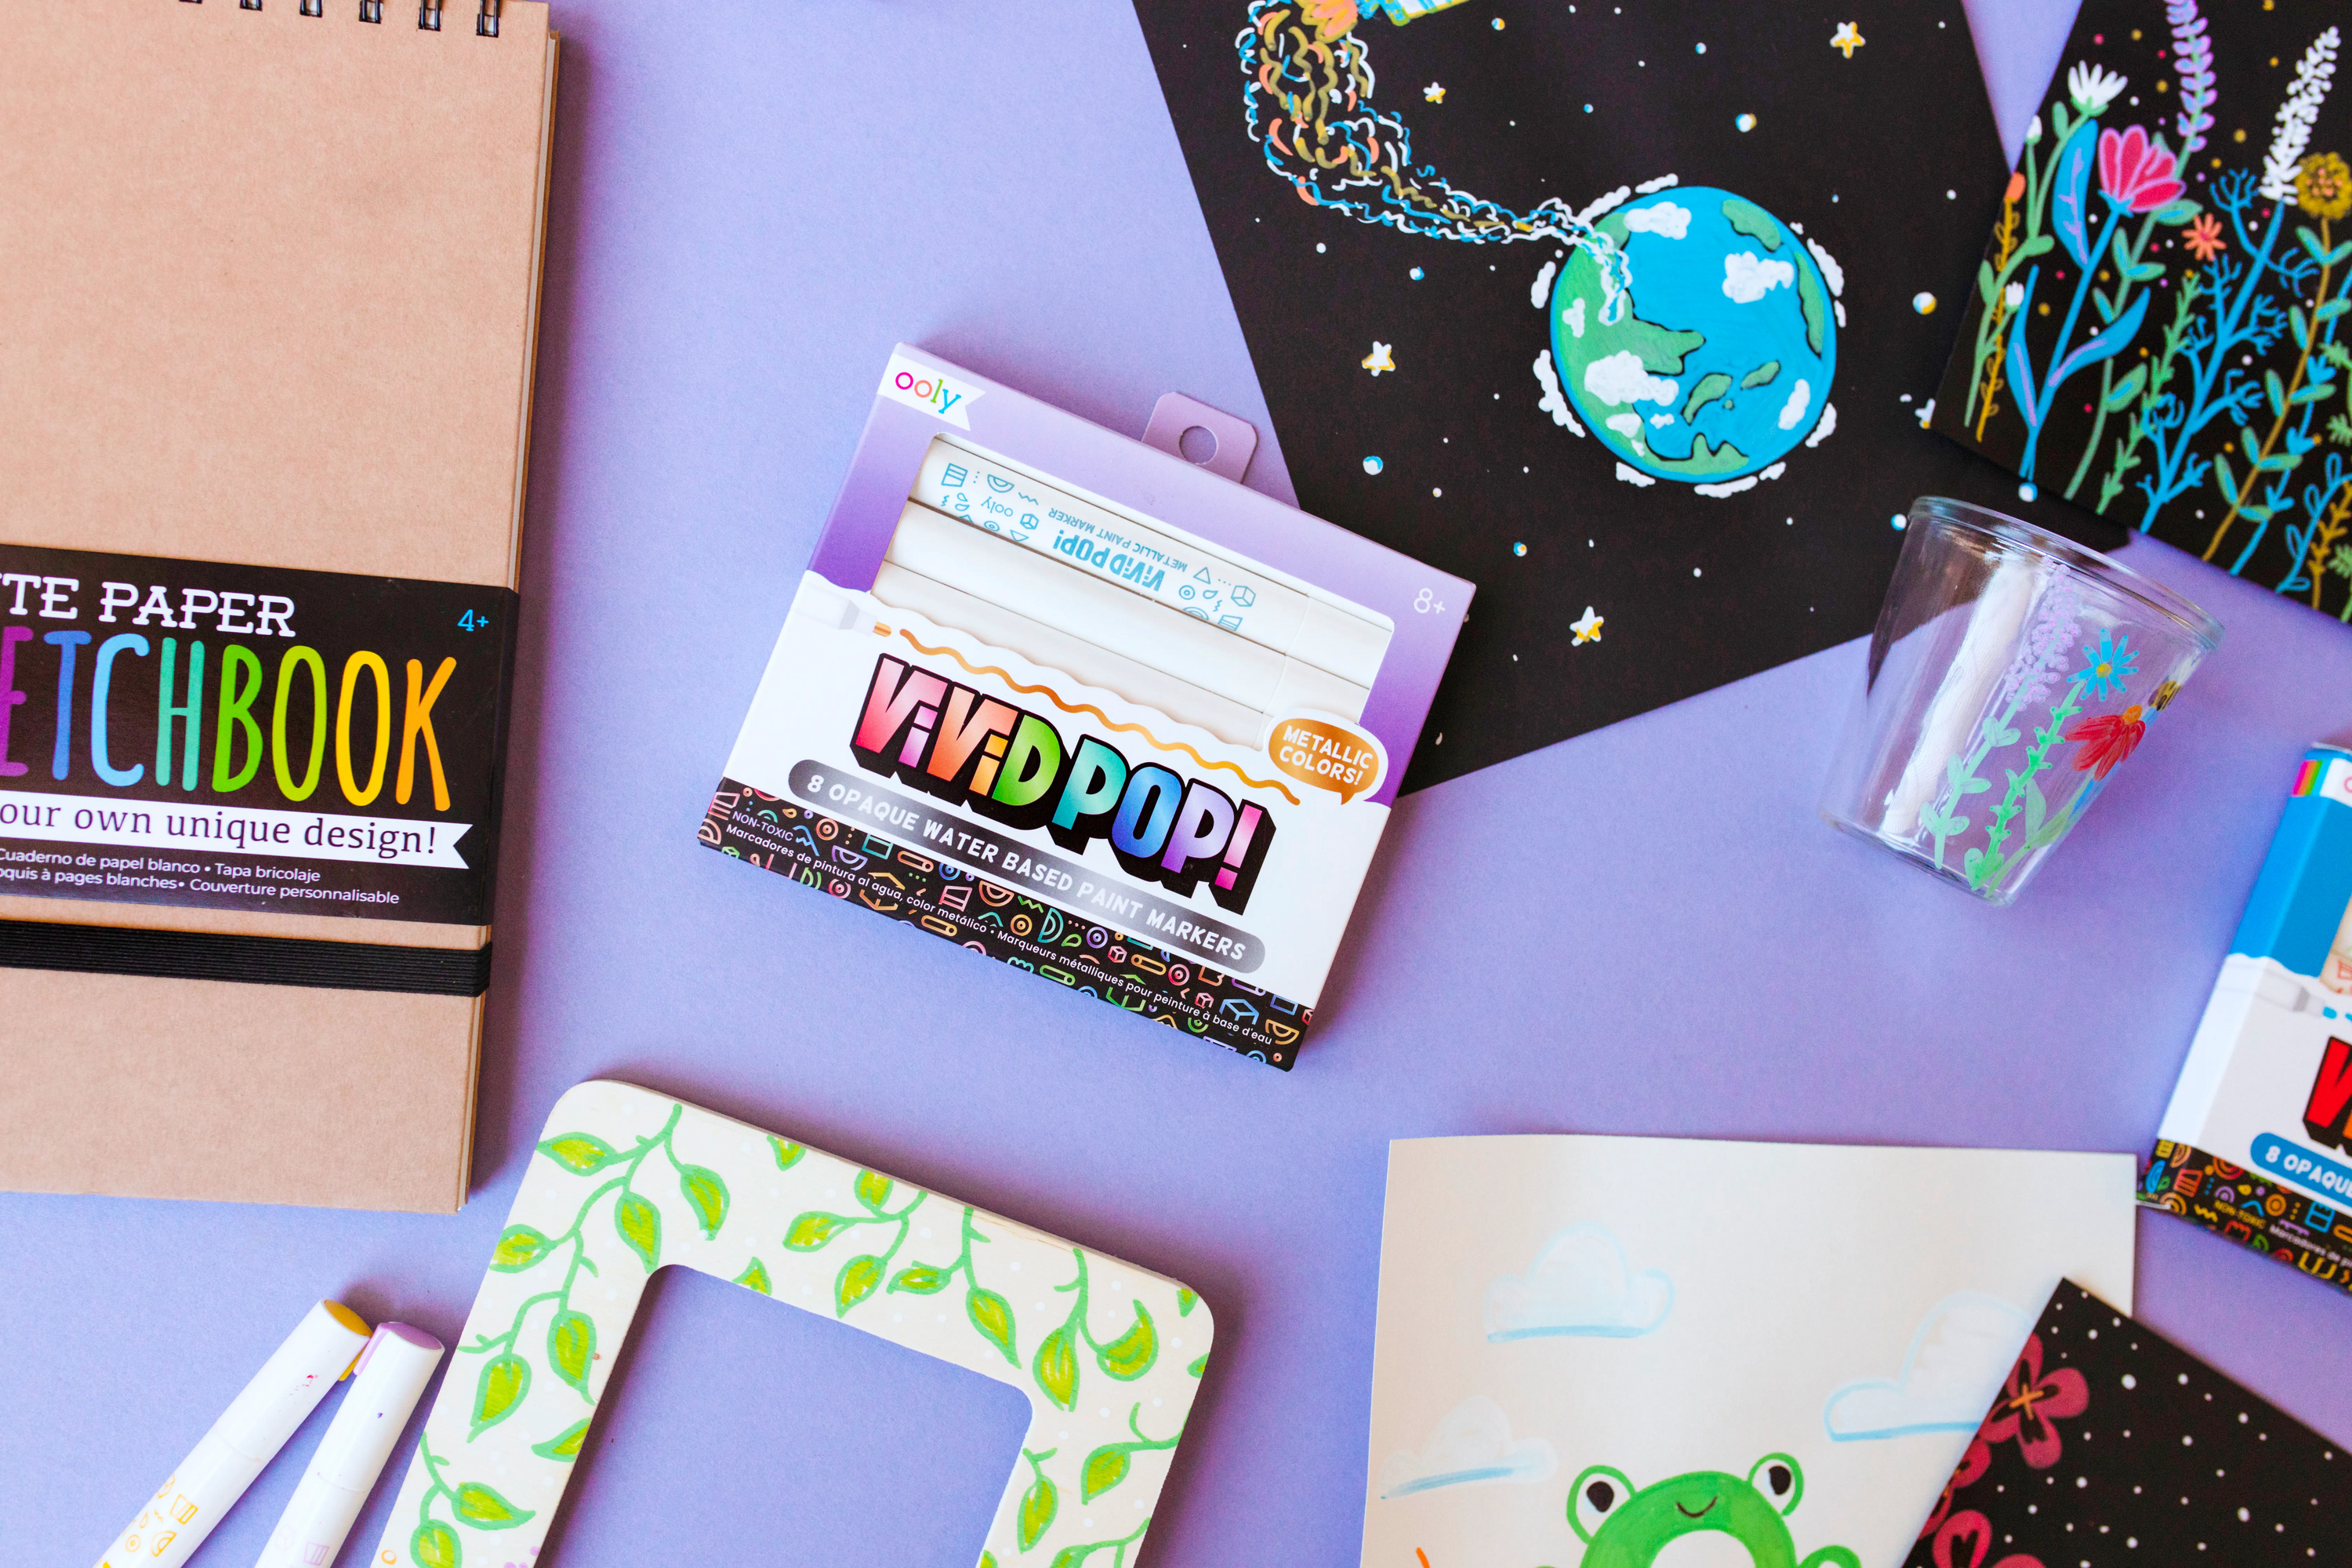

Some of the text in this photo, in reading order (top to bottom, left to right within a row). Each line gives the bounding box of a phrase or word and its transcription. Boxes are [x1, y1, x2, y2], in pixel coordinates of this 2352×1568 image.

[895, 372, 962, 414] ooly
[980, 495, 1014, 517] ooly
[1047, 506, 1188, 573] METALLIC PAINT MARKER
[1052, 529, 1112, 570] POP!
[0, 572, 296, 637] TE PAPER
[458, 608, 489, 633] 4+
[1414, 587, 1446, 614] 8+
[1279, 746, 1363, 786] COLORS!
[1283, 725, 1374, 769] METALLIC
[74, 808, 151, 834] own
[167, 811, 290, 849] unique
[304, 818, 434, 858] design!
[732, 811, 794, 842] NON-TOXIC
[1051, 739, 1263, 891] POP!
[41, 868, 51, 881] à
[54, 870, 103, 886] pages
[190, 878, 277, 897] Couverture
[279, 886, 400, 905] personnalisable
[75, 853, 97, 866] de
[99, 857, 144, 871] papel
[147, 858, 201, 873] blanco
[214, 862, 252, 878] Tapa
[256, 866, 321, 884] bricolaje
[806, 775, 1247, 961] 8 OPAQUE WATER BASED PAINT MARKERS
[726, 823, 1273, 1046] Marcadores de pintura al agua, color metálico Marqueurs métalliques pour peinture à base d'eau
[2265, 1145, 2281, 1163] 8
